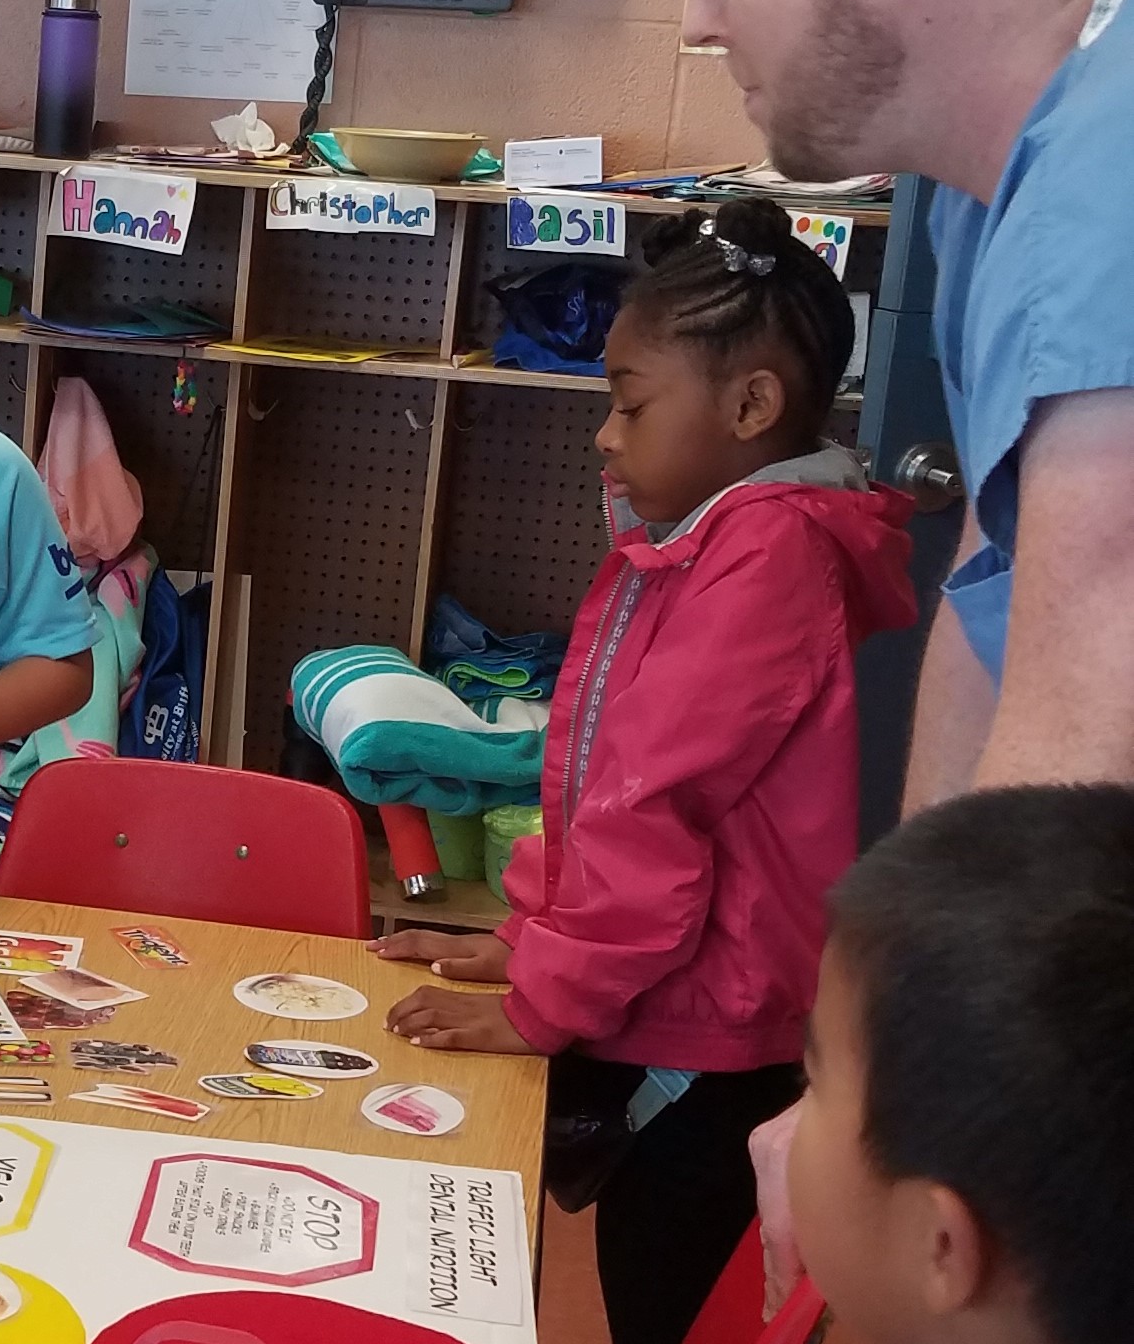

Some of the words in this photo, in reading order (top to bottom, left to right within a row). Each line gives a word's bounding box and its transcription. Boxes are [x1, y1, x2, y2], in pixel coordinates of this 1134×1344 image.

[62, 178, 183, 244] Hannah
[509, 197, 616, 246] Basil
[303, 1195, 342, 1251] STOP
[429, 1173, 456, 1224] DENTAL
[466, 1179, 495, 1238] TRAFFIC
[429, 1226, 459, 1314] NUTRITION
[468, 1238, 498, 1287] LIGHT
